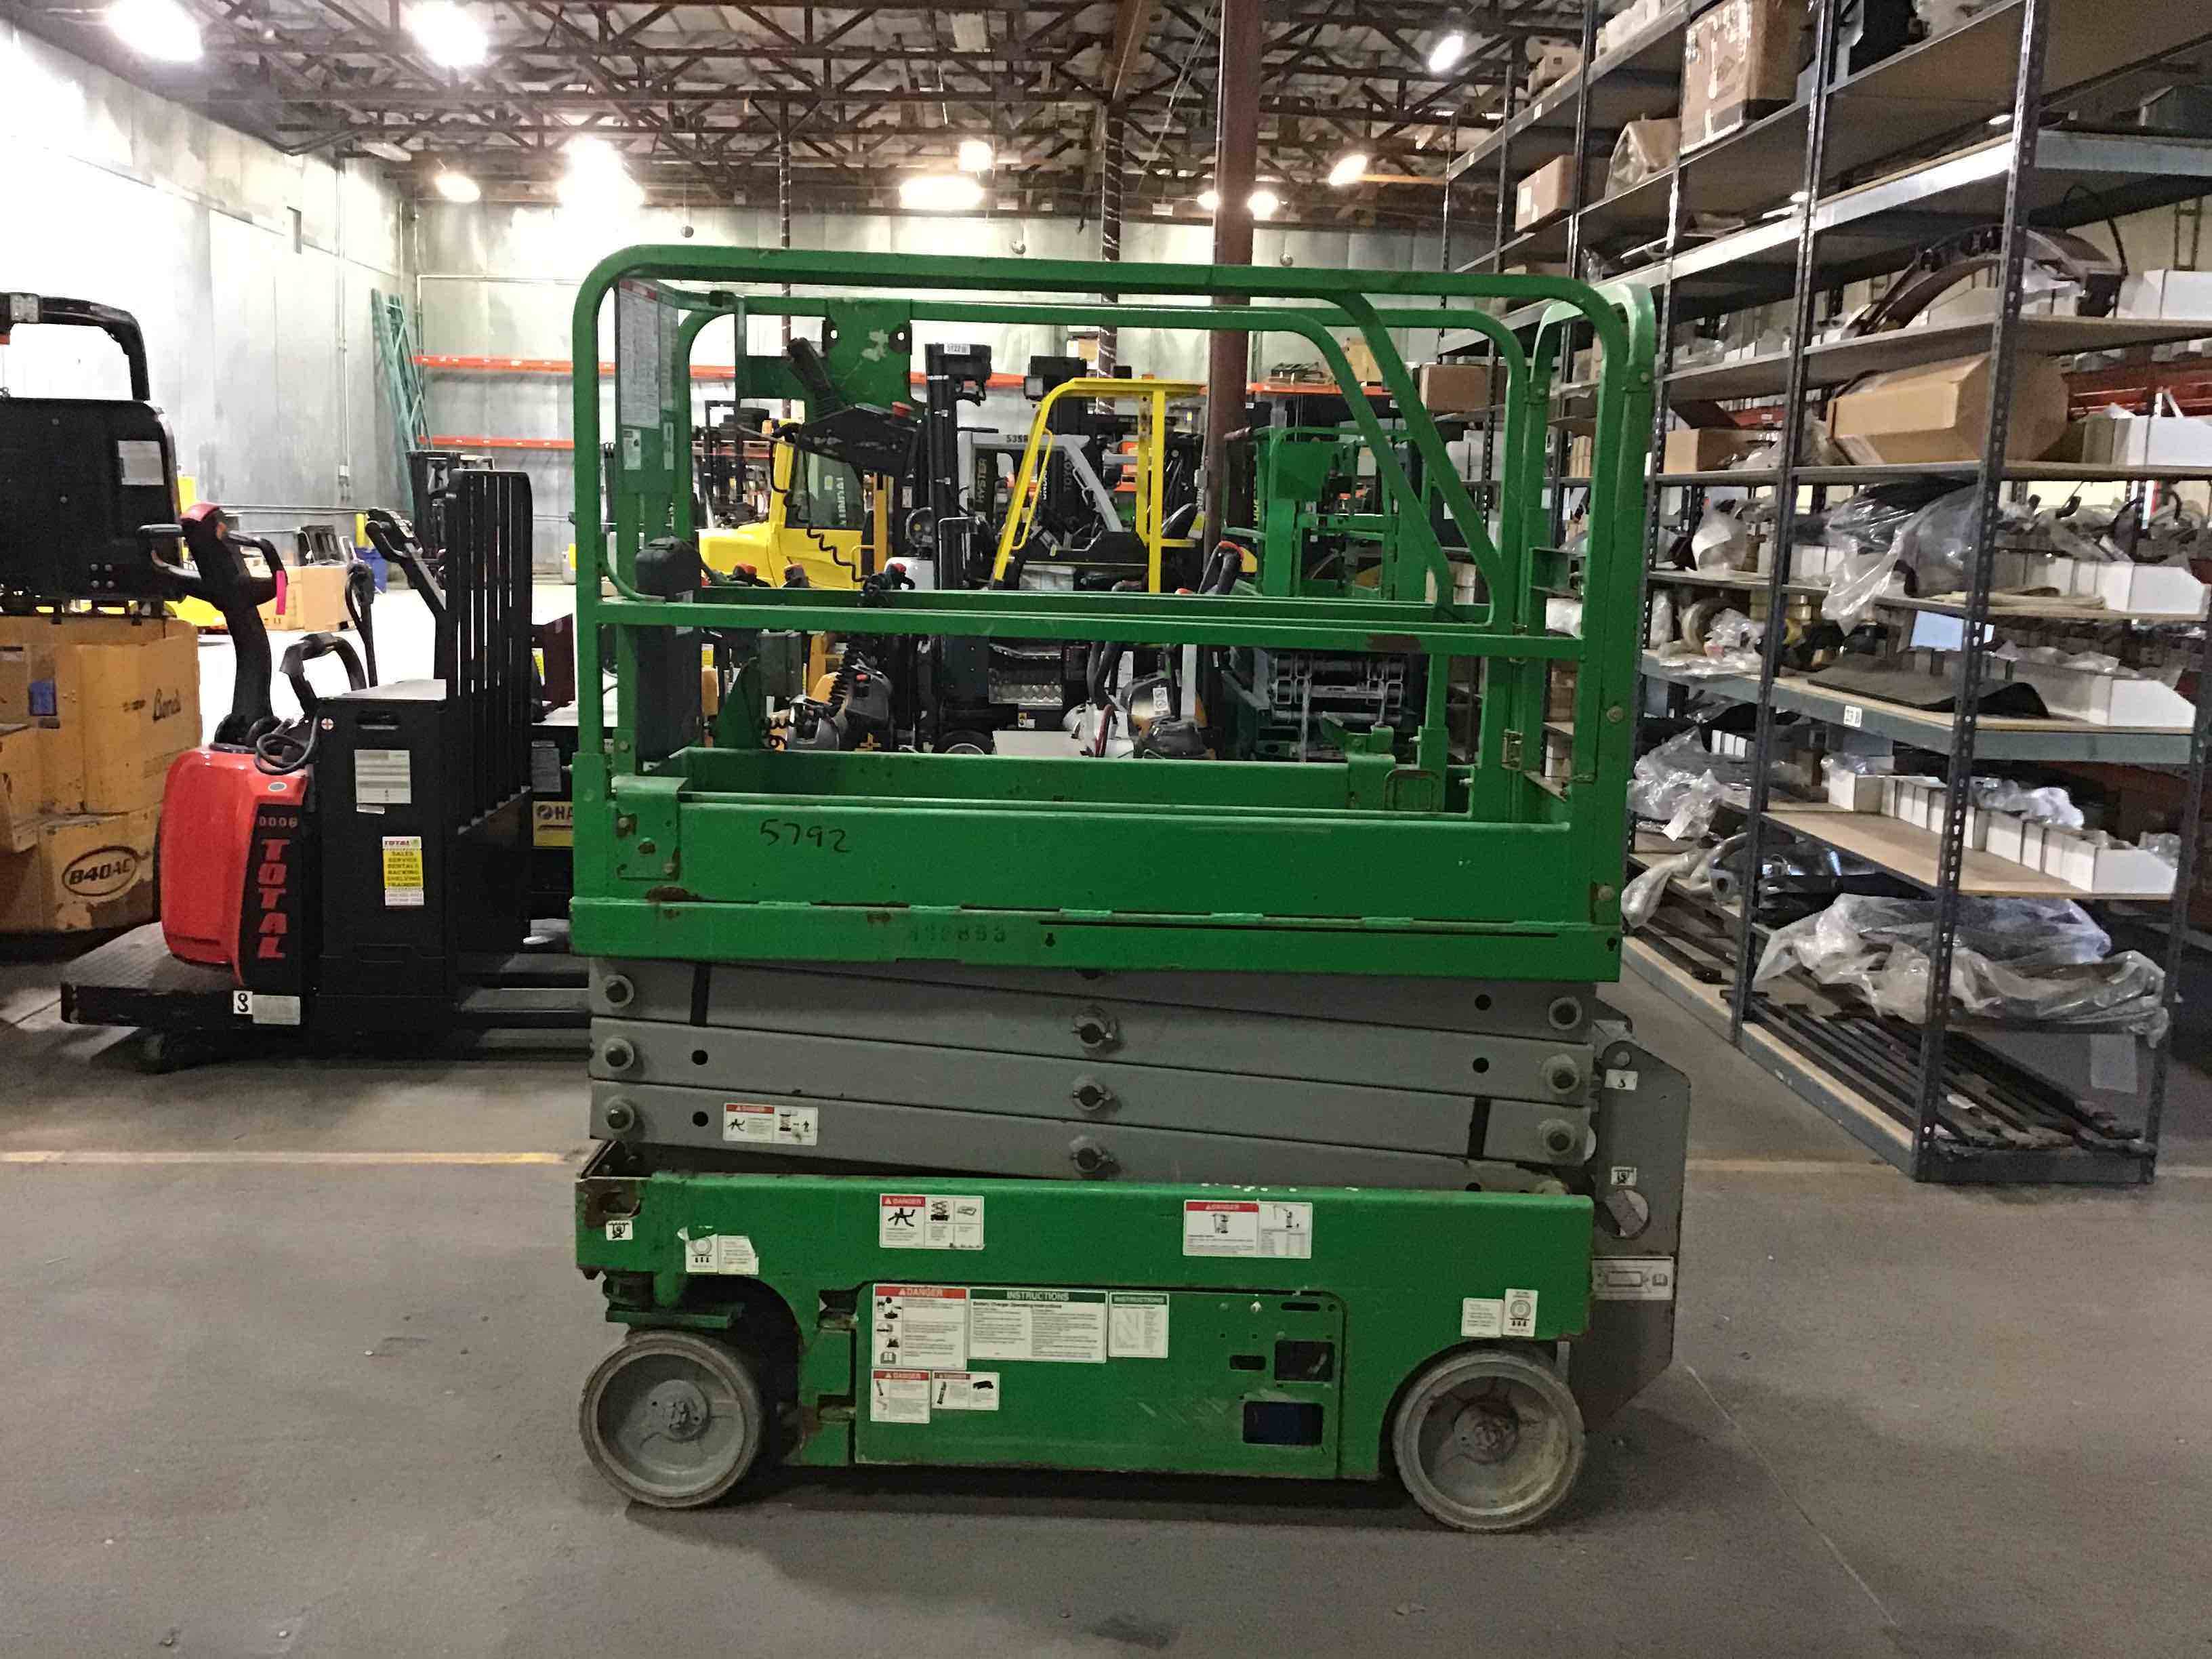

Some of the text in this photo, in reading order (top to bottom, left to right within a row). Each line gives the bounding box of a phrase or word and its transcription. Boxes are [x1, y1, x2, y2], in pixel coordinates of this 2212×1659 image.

[975, 457, 987, 503] HYSTER
[760, 818, 851, 853] 5792
[68, 857, 131, 885] B40AC
[258, 838, 291, 958] TOTAL
[905, 1288, 944, 1298] DANGER
[1006, 1290, 1070, 1301] INSTRUCTIONS
